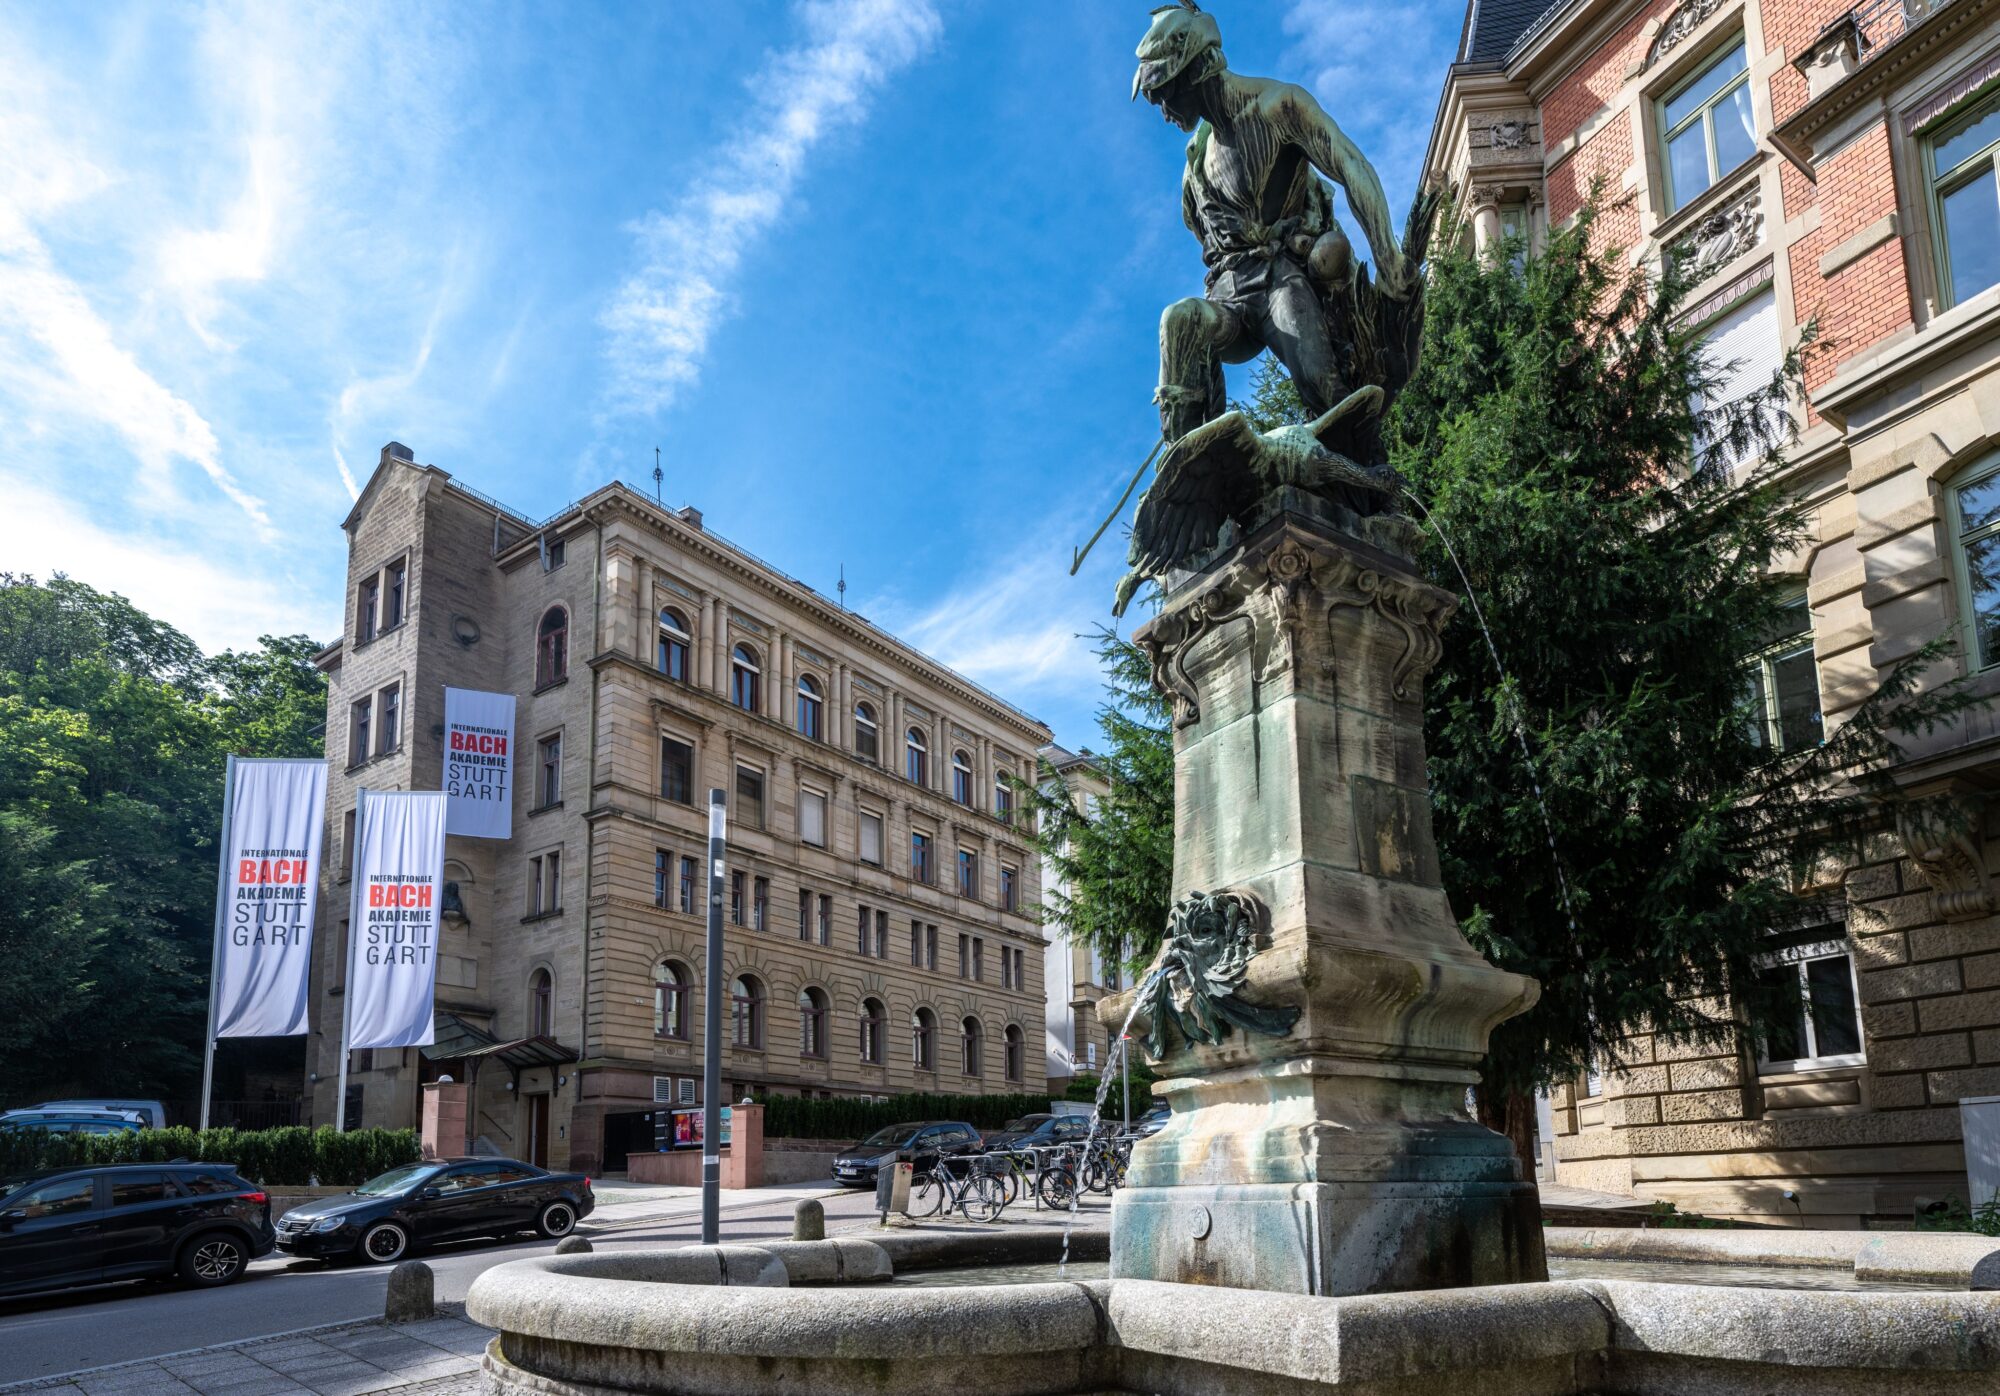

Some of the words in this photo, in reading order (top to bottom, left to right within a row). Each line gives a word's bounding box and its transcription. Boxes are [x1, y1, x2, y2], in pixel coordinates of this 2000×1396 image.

[451, 723, 507, 736] INTERNATIONALE
[450, 731, 507, 756] BACH
[449, 752, 506, 768] AKADEMIE
[449, 764, 507, 785] STUTT
[448, 781, 507, 802] GART
[241, 849, 308, 858] INTERNATIONALE
[239, 860, 308, 884] BACH
[370, 874, 432, 883] INTERNATIONALE
[236, 886, 306, 899] AKADEMIE
[369, 884, 432, 907] BACH
[234, 902, 307, 923] STUTT
[368, 910, 431, 922] AKADEMIE
[233, 925, 306, 946] GART
[367, 925, 432, 944] STUTT
[366, 946, 431, 965] GART
